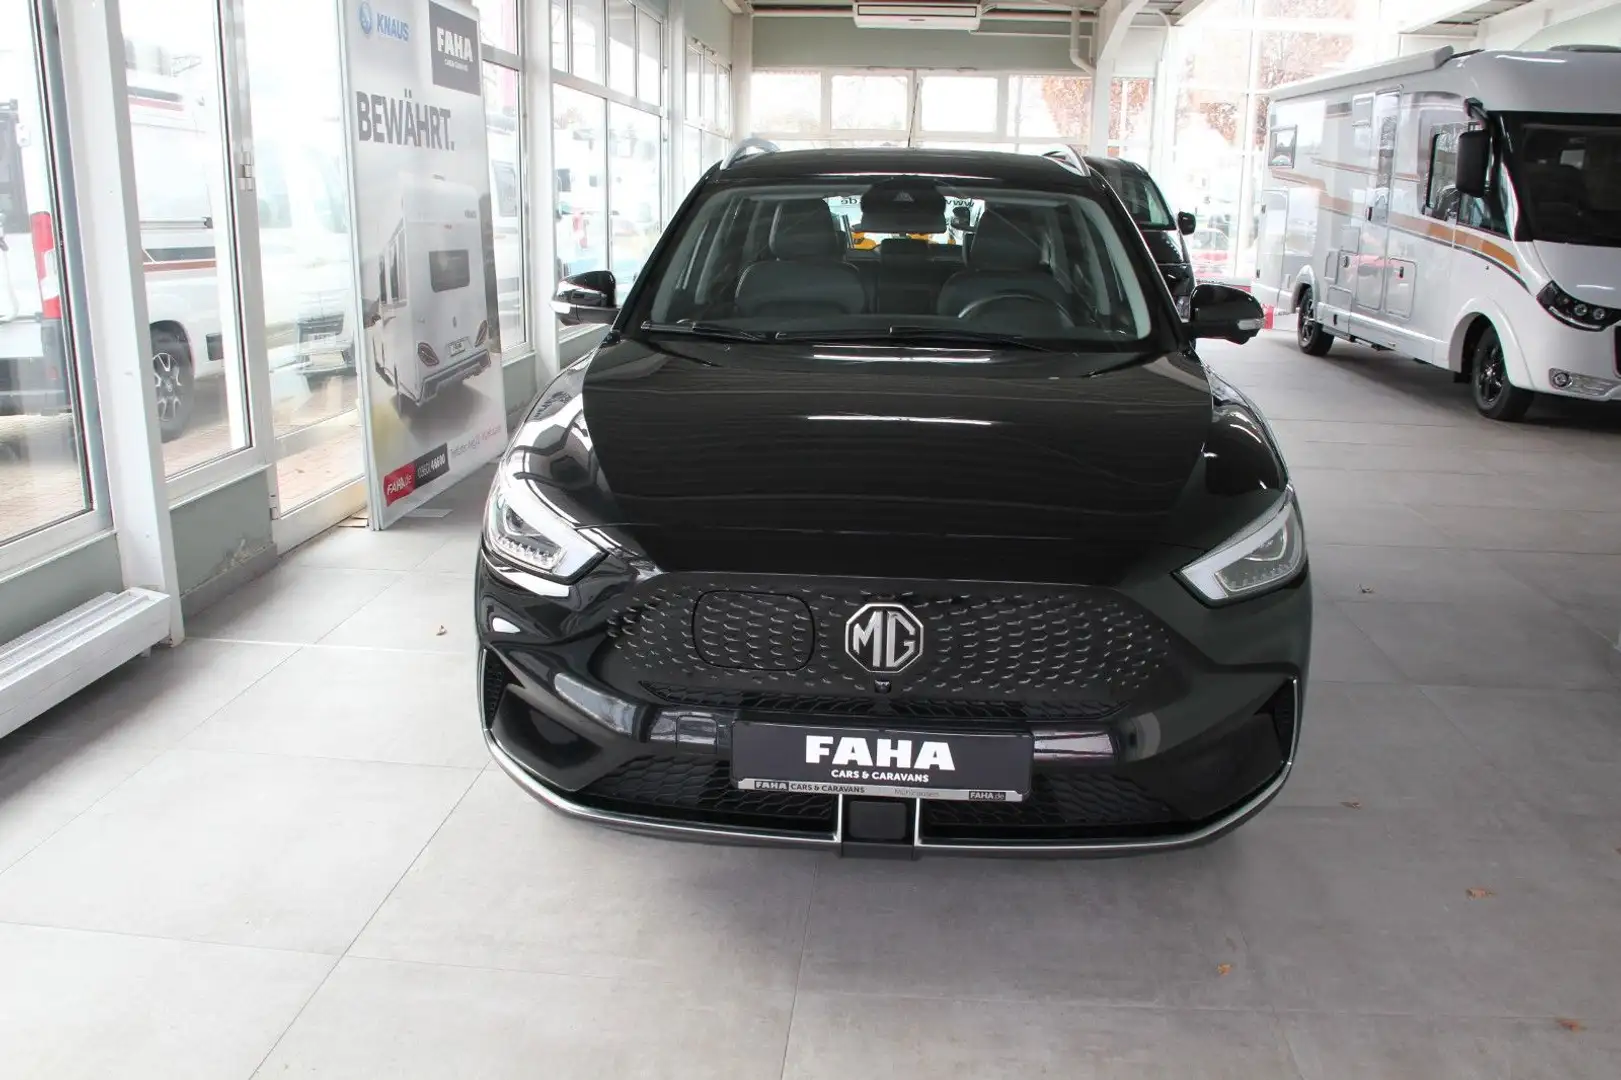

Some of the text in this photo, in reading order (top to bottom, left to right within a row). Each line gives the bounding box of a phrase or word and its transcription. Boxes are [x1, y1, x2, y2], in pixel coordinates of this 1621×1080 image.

[376, 13, 410, 42] KNAUS
[436, 26, 474, 62] FAHA
[356, 88, 455, 151] BEWÄHRT.
[852, 610, 916, 667] MG
[805, 735, 956, 771] FAHA
[755, 780, 788, 790] FAHA
[790, 784, 813, 792] CARS
[821, 785, 866, 794] CARAVANS
[970, 791, 1005, 801] FAHA.de
[831, 769, 930, 782] CARS & CARAVANS
